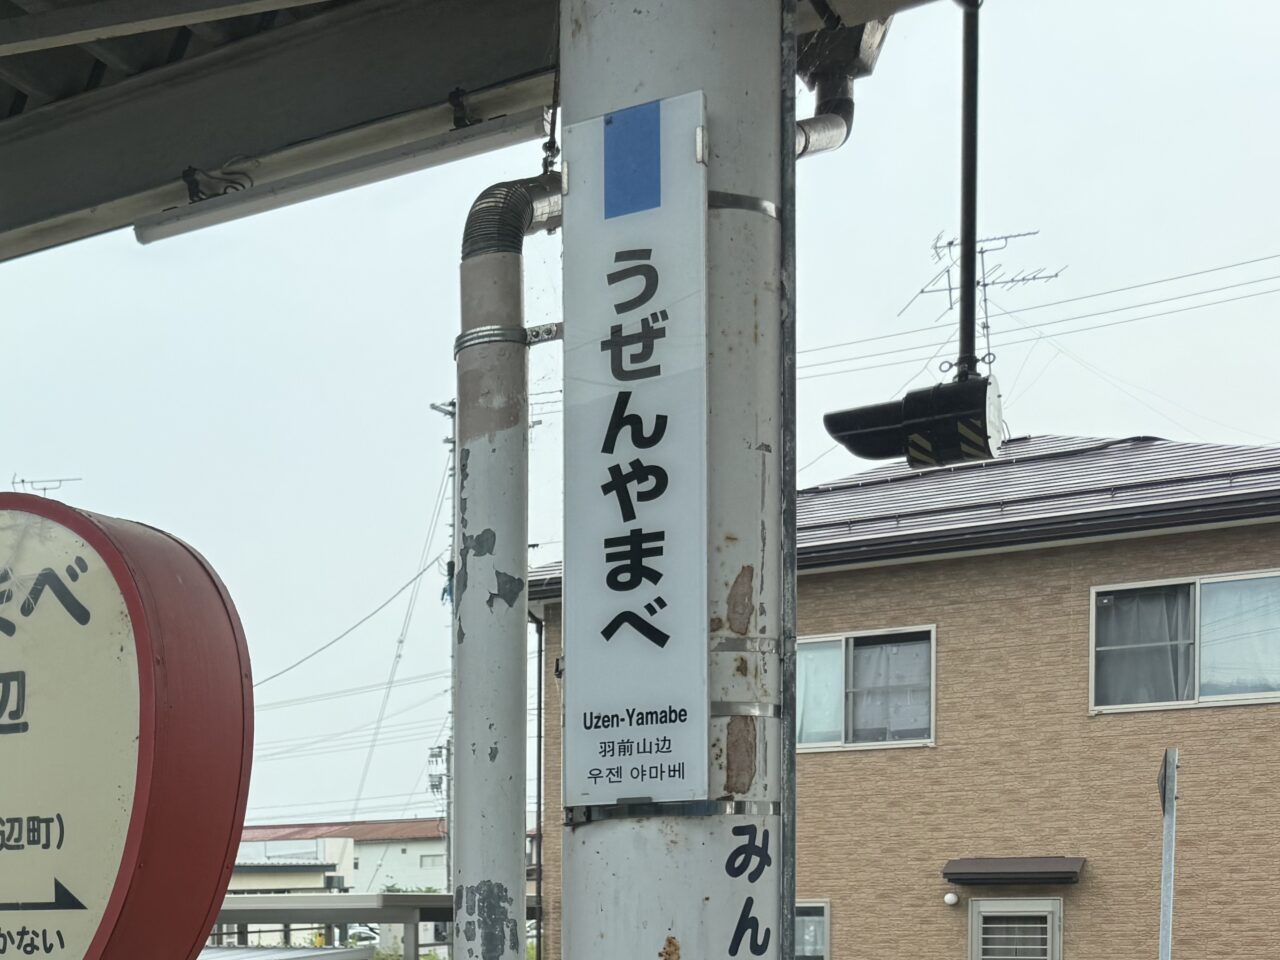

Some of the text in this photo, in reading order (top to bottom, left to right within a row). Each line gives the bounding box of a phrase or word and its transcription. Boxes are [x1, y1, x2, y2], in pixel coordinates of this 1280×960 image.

[600, 248, 671, 649] うぜんやまべ
[583, 705, 688, 730] Uzen-Yamabe
[587, 762, 685, 785] 우젠 야마베
